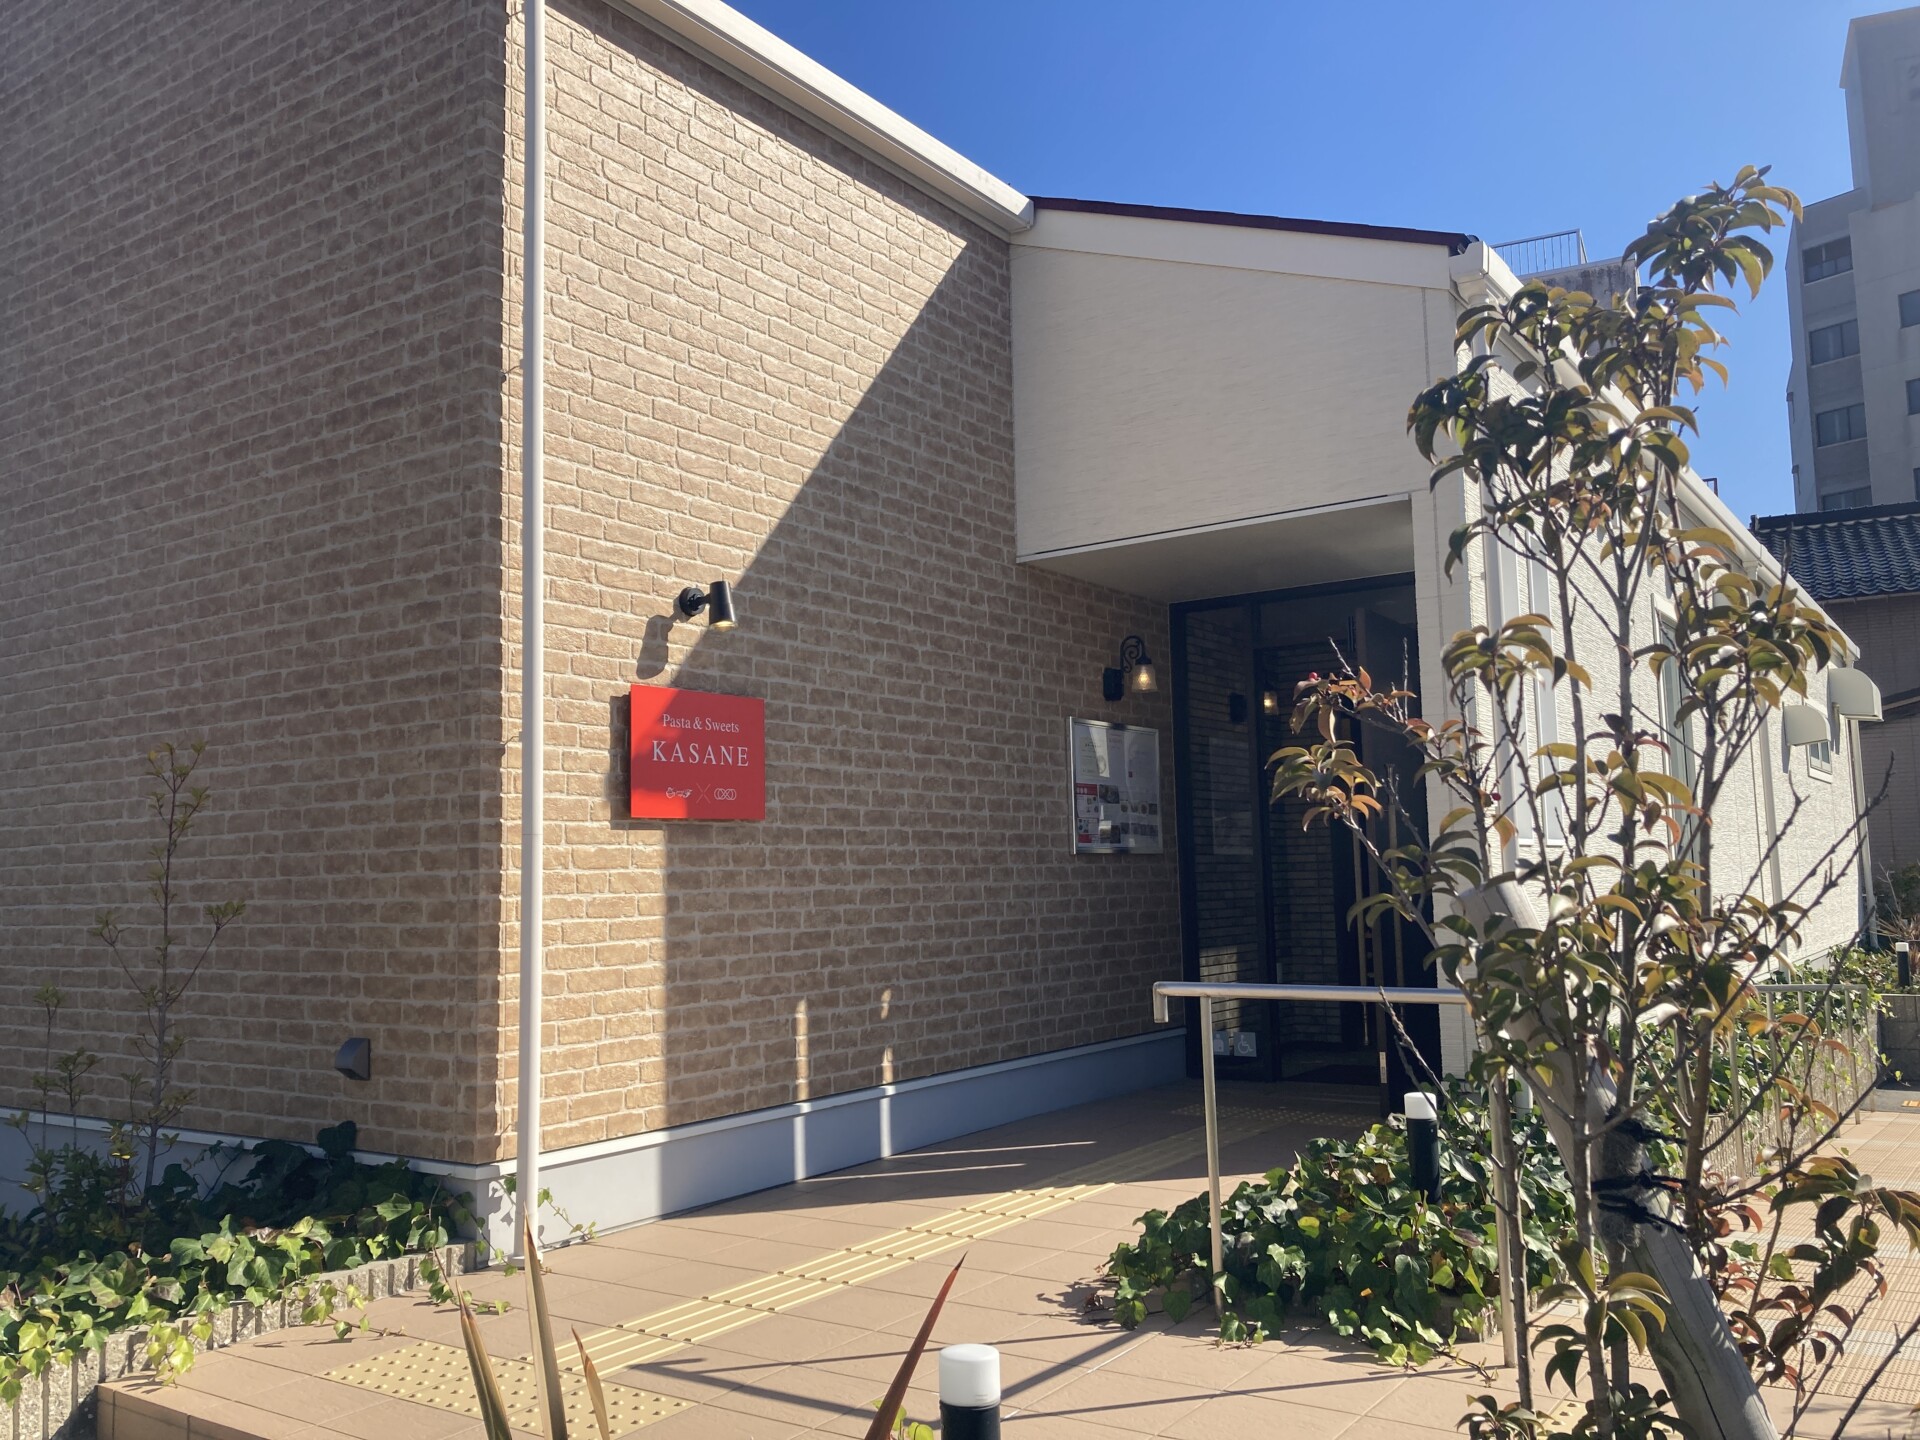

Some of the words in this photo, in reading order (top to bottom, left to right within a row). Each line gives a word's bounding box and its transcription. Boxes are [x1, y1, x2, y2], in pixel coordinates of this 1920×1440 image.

[663, 714, 691, 729] Pasta
[693, 717, 702, 730] &
[705, 718, 739, 733] Sweets
[652, 740, 749, 767] KASANE
